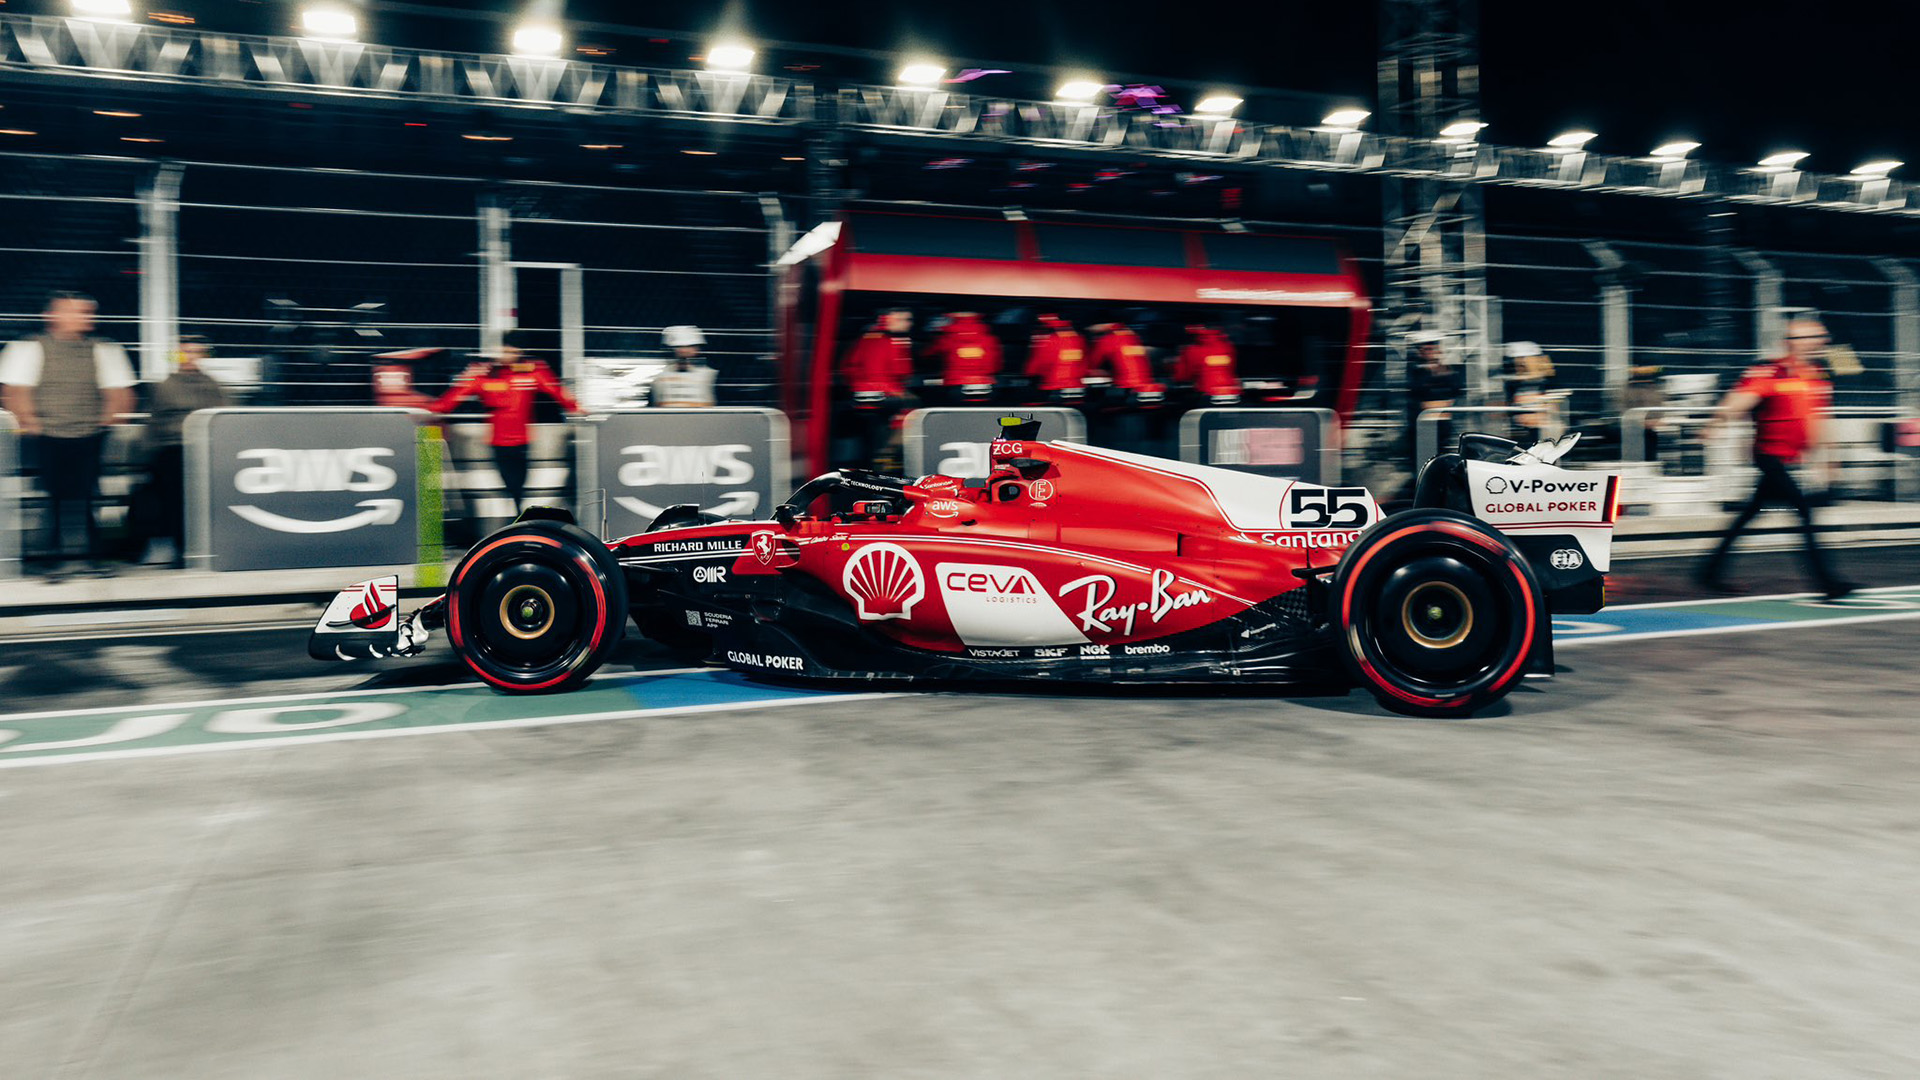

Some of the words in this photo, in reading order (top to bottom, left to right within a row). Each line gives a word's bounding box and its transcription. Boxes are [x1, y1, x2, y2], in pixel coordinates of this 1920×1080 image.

[234, 447, 398, 494] aws
[618, 444, 755, 486] aws
[850, 480, 884, 492] TECHNOLOGY
[1510, 479, 1598, 493] V-Power
[932, 500, 959, 511] aws
[1291, 488, 1369, 529] 55
[1485, 503, 1543, 514] GLOBAL
[1548, 501, 1597, 512] POKER
[654, 542, 703, 553] RICHARD
[707, 540, 742, 551] MILLE
[986, 596, 1037, 604] LOGISTICS
[1058, 568, 1212, 636] Ray-Ban
[1034, 648, 1068, 657] SKF
[1080, 645, 1110, 655] NGK
[1124, 644, 1171, 655] brembo
[727, 650, 764, 667] GLOBAL
[765, 655, 804, 670] POKER
